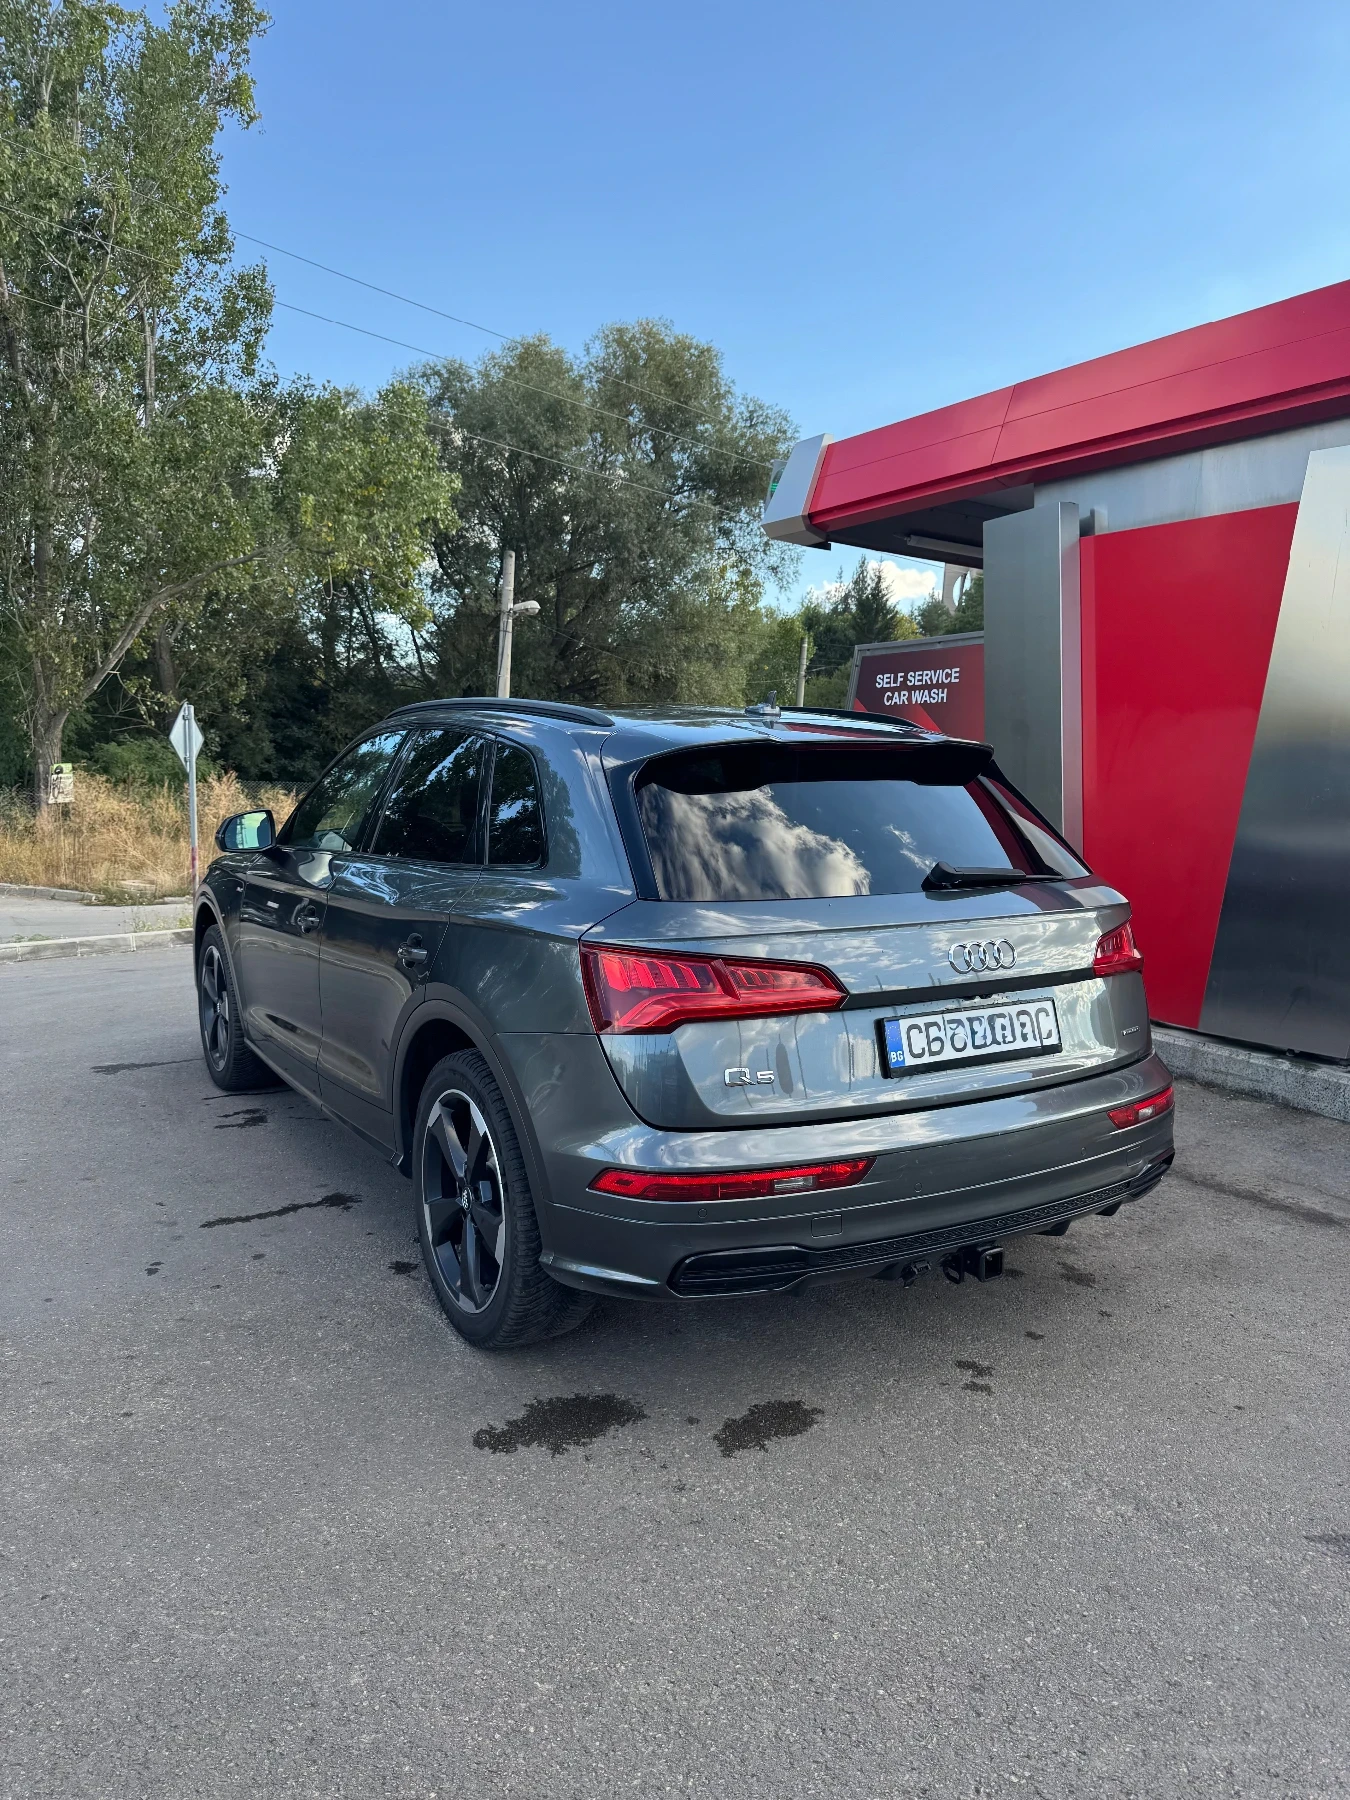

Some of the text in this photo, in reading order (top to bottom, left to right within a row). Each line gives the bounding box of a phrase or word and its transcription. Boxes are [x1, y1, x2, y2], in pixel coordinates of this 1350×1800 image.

[876, 668, 959, 688] SELF SERVICE
[884, 689, 947, 705] CAR WASH
[890, 1050, 904, 1063] BG
[724, 1067, 775, 1088] Q5
